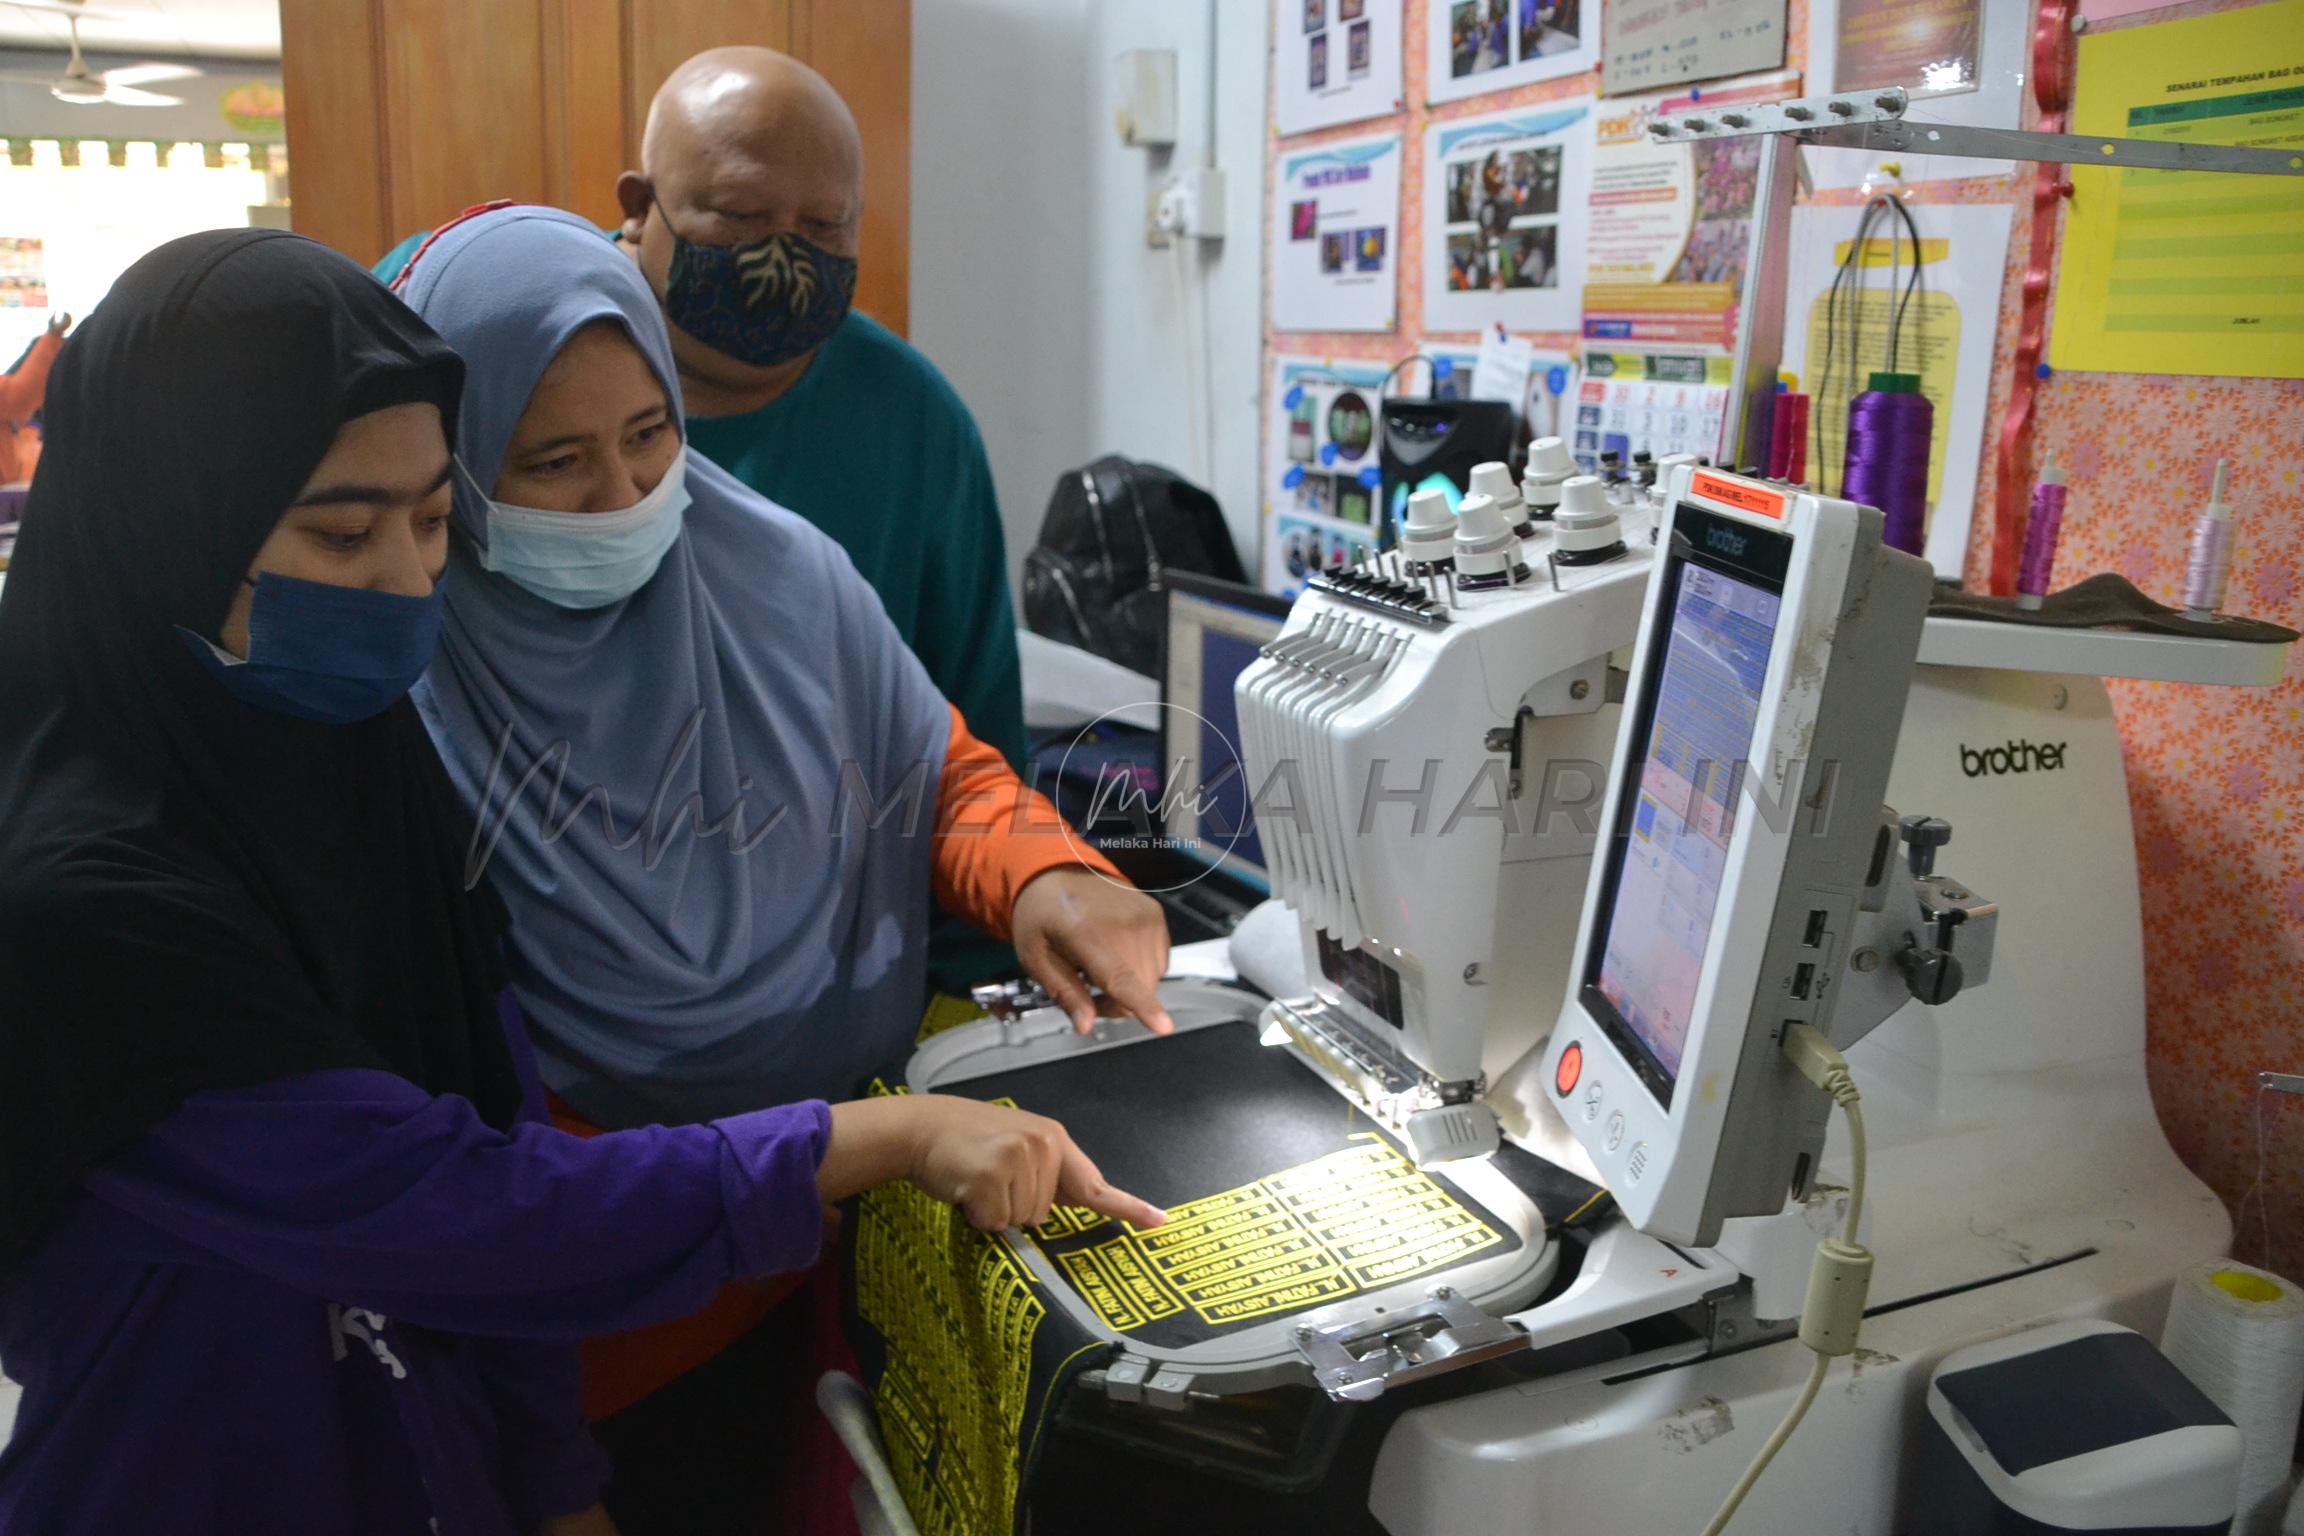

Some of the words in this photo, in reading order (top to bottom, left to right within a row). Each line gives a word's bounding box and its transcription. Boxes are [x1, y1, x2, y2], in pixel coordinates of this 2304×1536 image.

[2166, 79, 2208, 93] SENARAI
[2210, 71, 2265, 87] TEMPAHAN
[2268, 67, 2290, 79] BAG
[1960, 738, 2068, 777] brother
